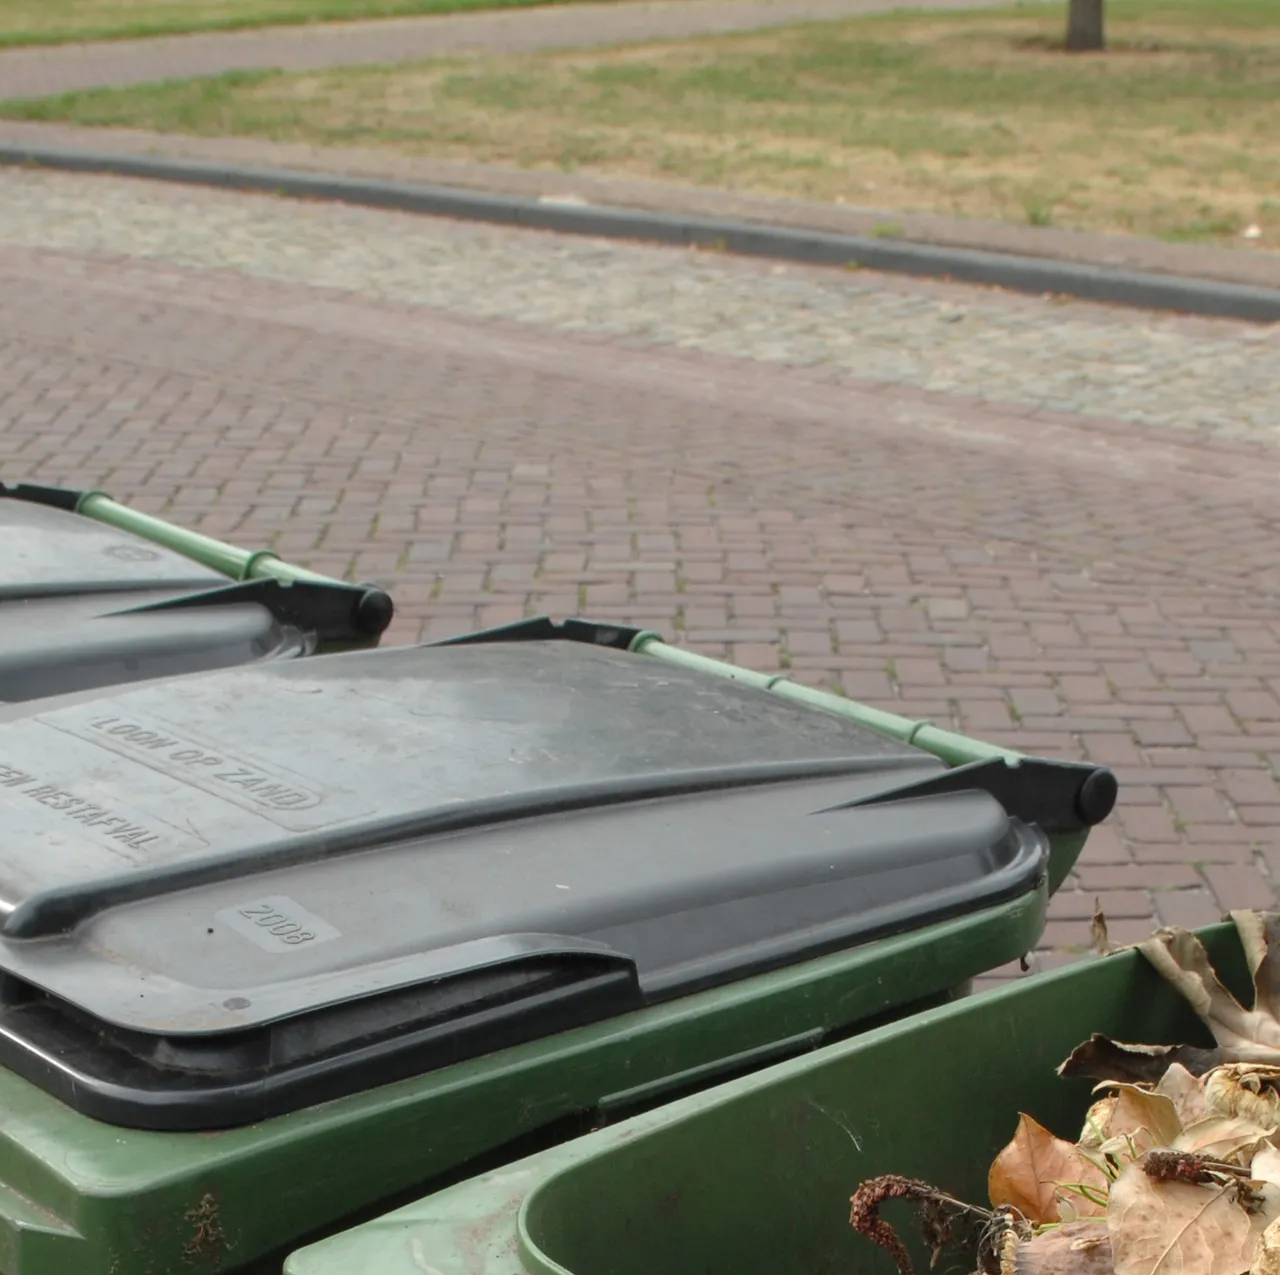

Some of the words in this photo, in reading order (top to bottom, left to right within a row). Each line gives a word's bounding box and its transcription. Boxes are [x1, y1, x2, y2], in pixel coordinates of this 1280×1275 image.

[91, 717, 179, 750] LOON
[169, 749, 224, 767] OP
[213, 767, 308, 806] ZAND
[21, 784, 159, 850] RESTAFVAL
[238, 904, 316, 945] 2008
